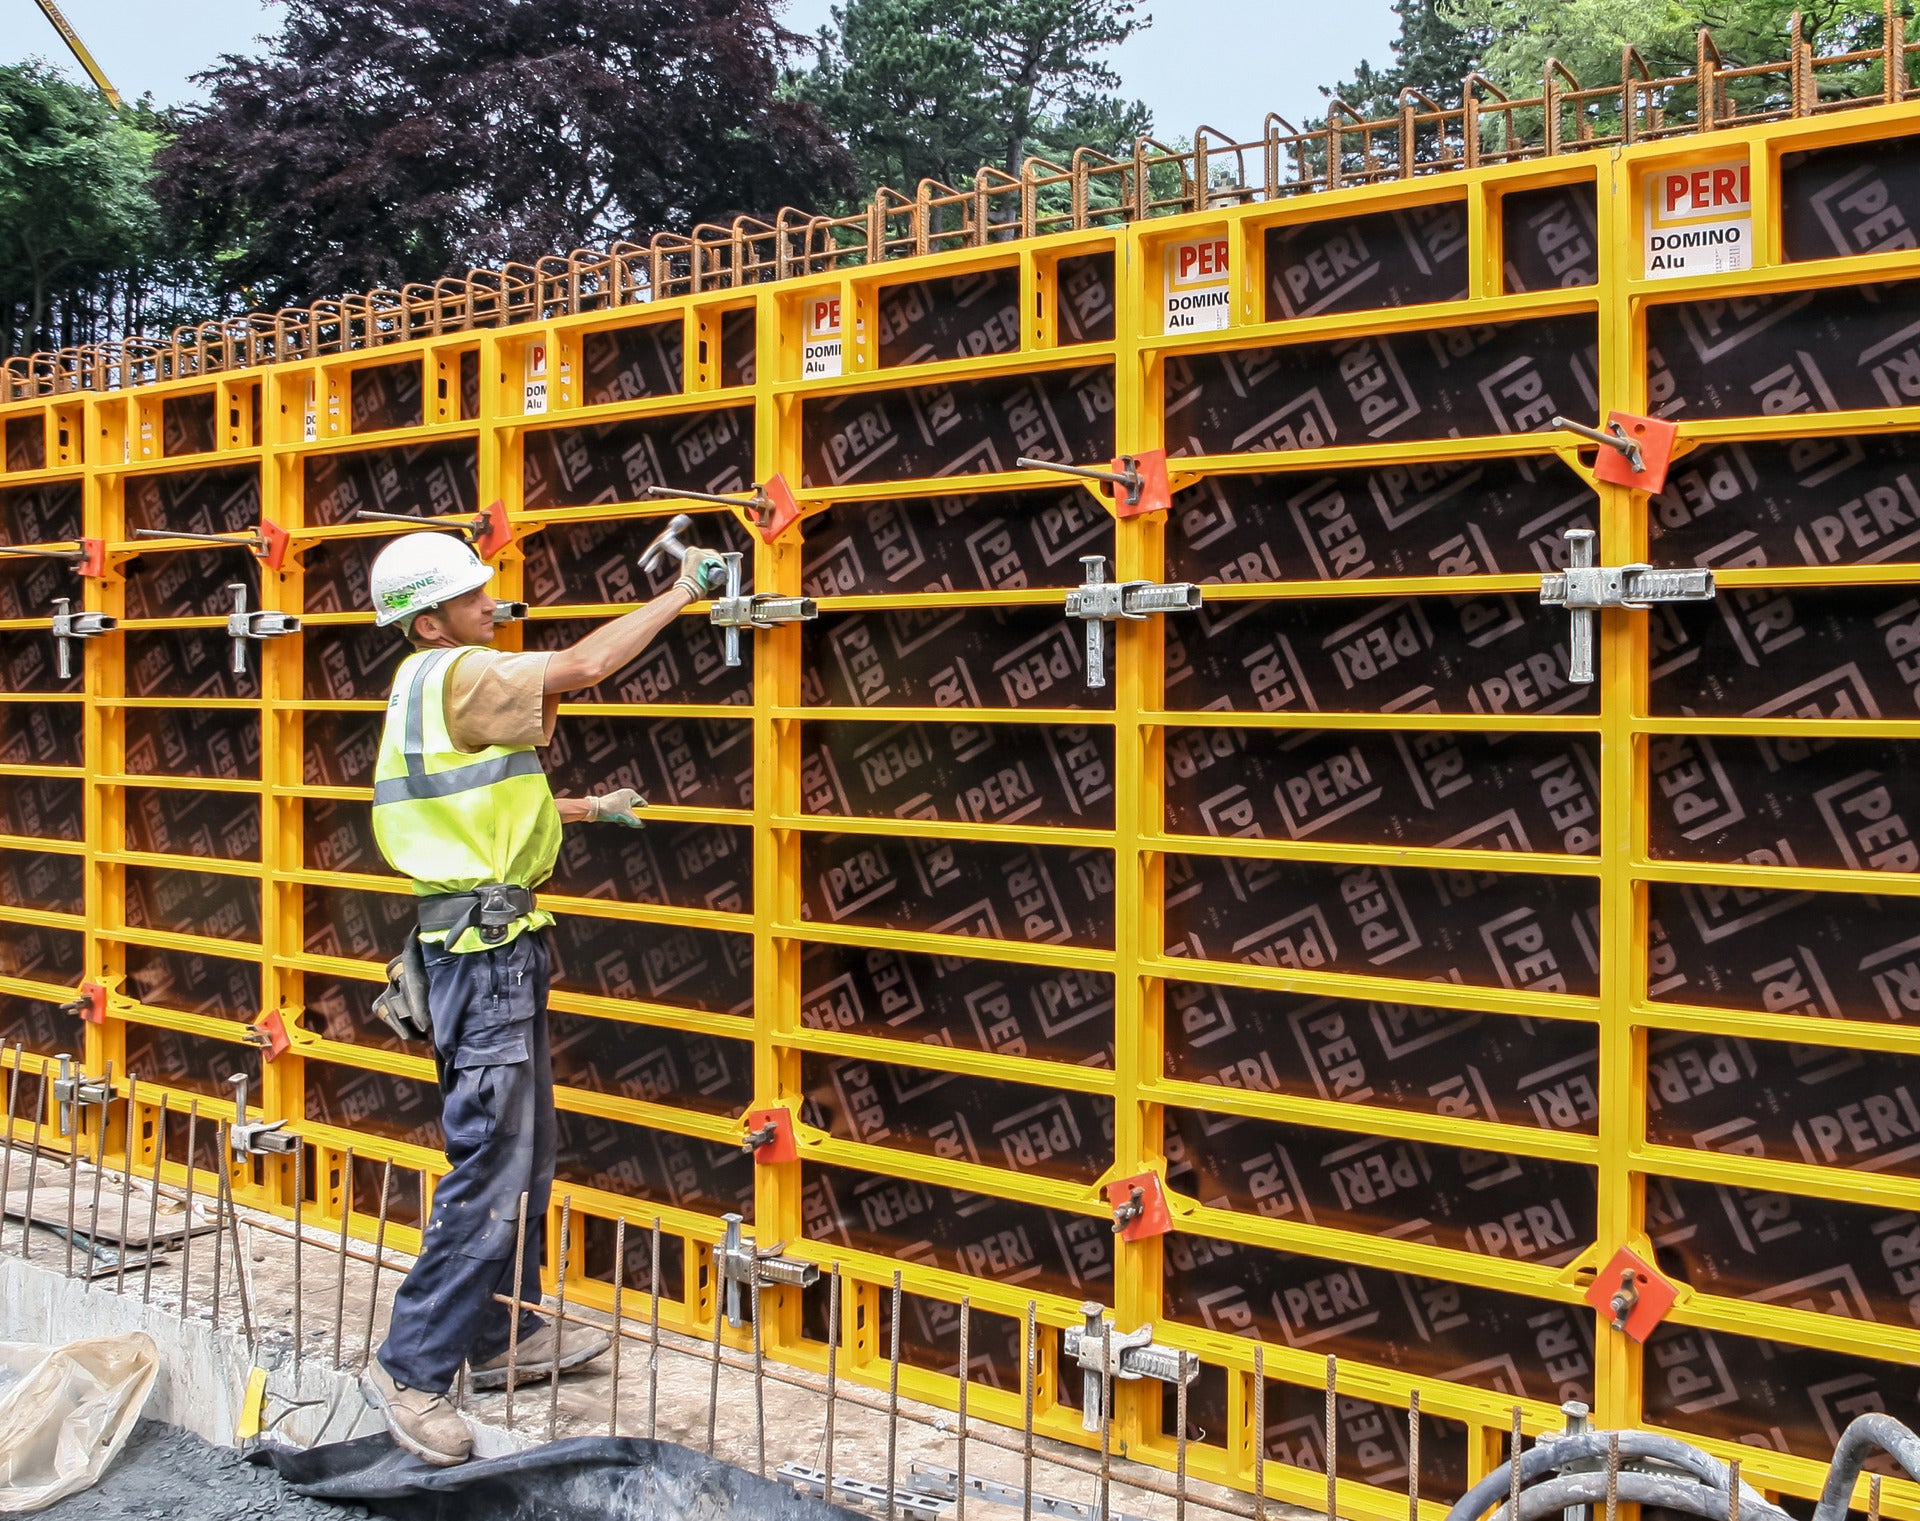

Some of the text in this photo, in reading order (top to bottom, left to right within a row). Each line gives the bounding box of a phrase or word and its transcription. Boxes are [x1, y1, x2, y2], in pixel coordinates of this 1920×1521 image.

[1667, 166, 1750, 212] PERI
[1180, 240, 1229, 278] PER
[1284, 224, 1371, 305] PERI
[1651, 227, 1740, 252] DOMINO
[1651, 255, 1685, 271] Alu
[815, 300, 840, 330] PE
[1169, 314, 1194, 328] Alu
[805, 361, 825, 374] Alu
[830, 402, 892, 468] PERI
[1810, 473, 1920, 562] PERI
[842, 624, 891, 707] PERI
[1001, 640, 1072, 708] PERI
[1331, 612, 1422, 690] PERI
[859, 730, 925, 795] PERI
[966, 760, 1035, 822] PERI
[1285, 746, 1373, 818] PERI
[1652, 737, 1720, 825] PER
[828, 843, 891, 903] PERI
[1001, 853, 1056, 941] PERI
[1000, 1114, 1071, 1172] PERI
[1808, 1086, 1920, 1163] PERI
[1329, 1145, 1419, 1211] PERI
[1478, 1198, 1576, 1258] PERI
[1283, 1267, 1370, 1329] PERI
